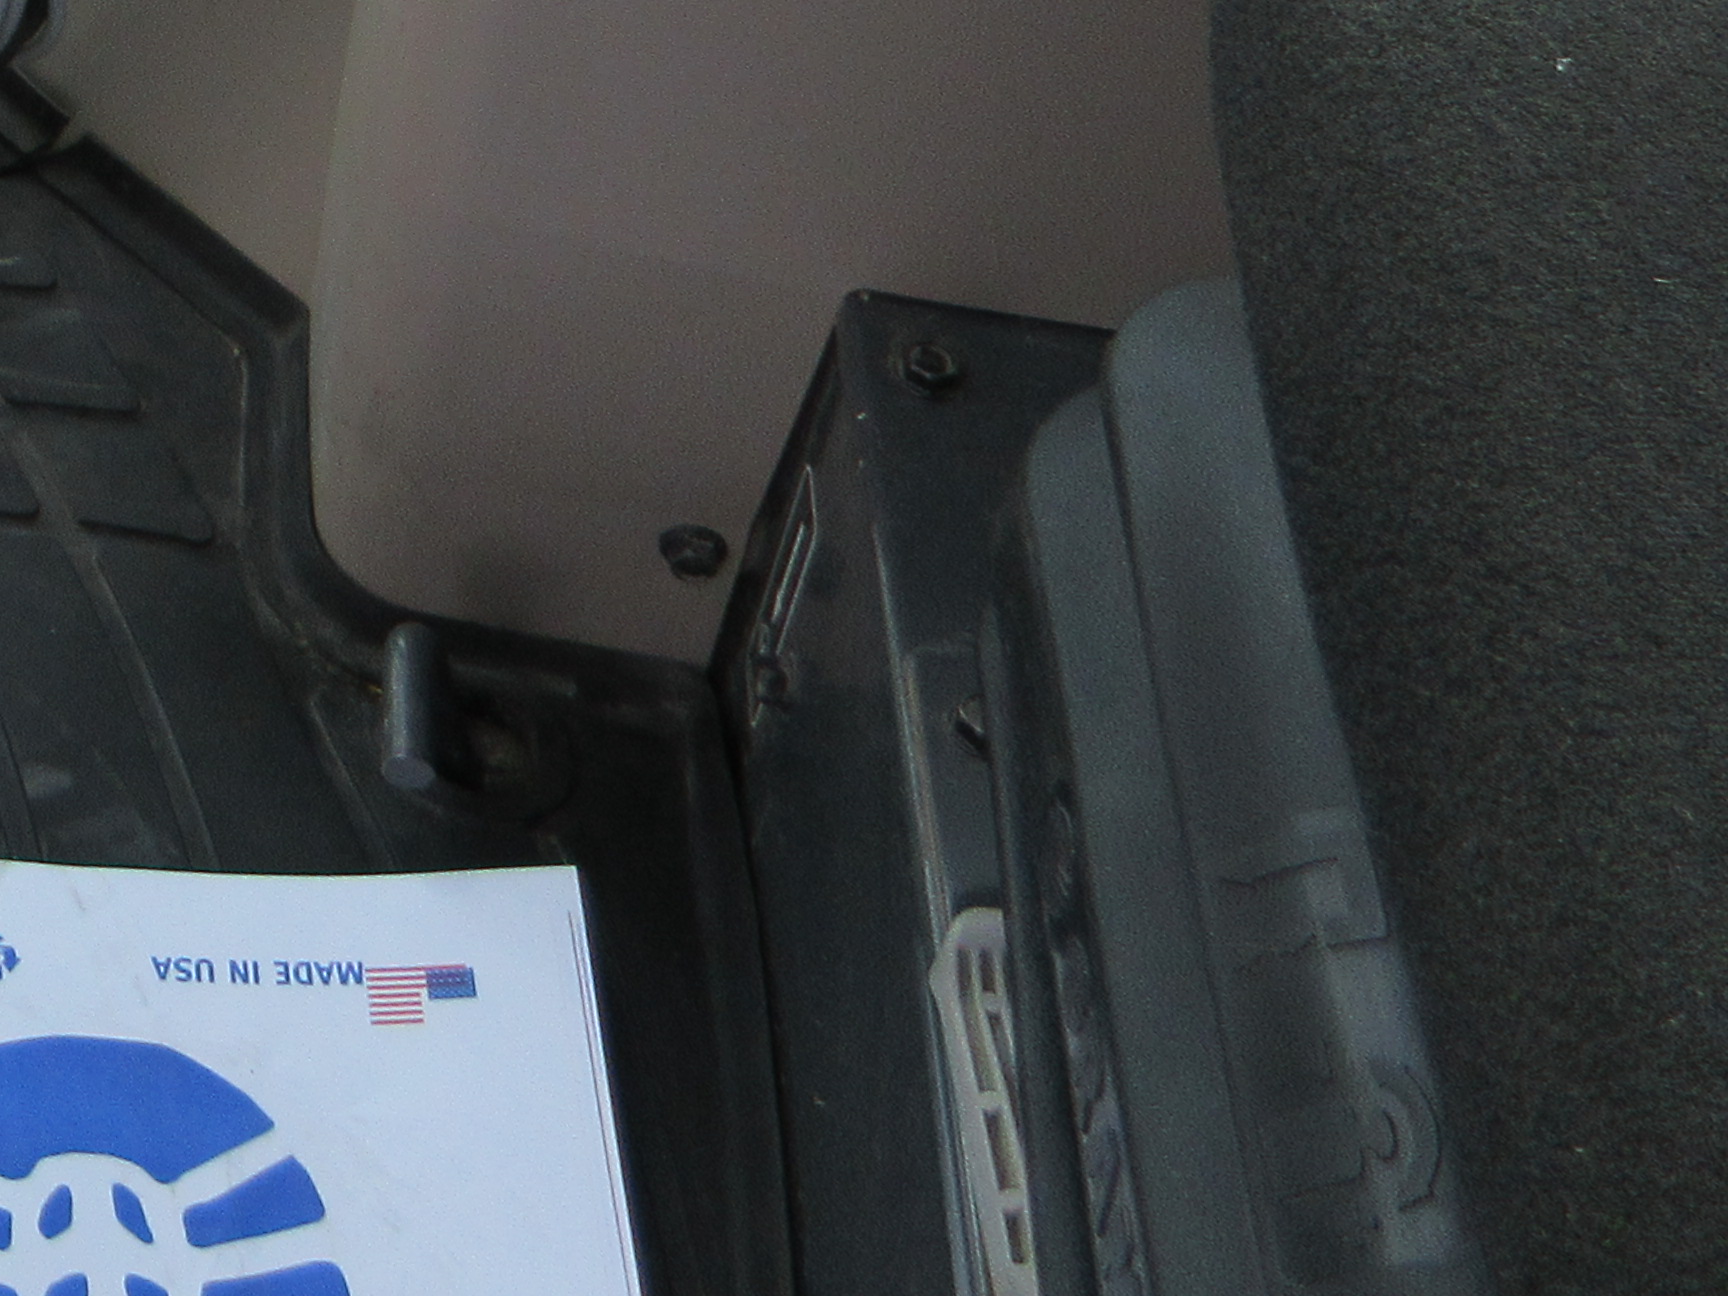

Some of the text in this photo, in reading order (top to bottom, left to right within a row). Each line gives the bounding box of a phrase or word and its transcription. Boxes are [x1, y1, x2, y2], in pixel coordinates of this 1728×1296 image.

[152, 956, 363, 985] MADE IN USA
